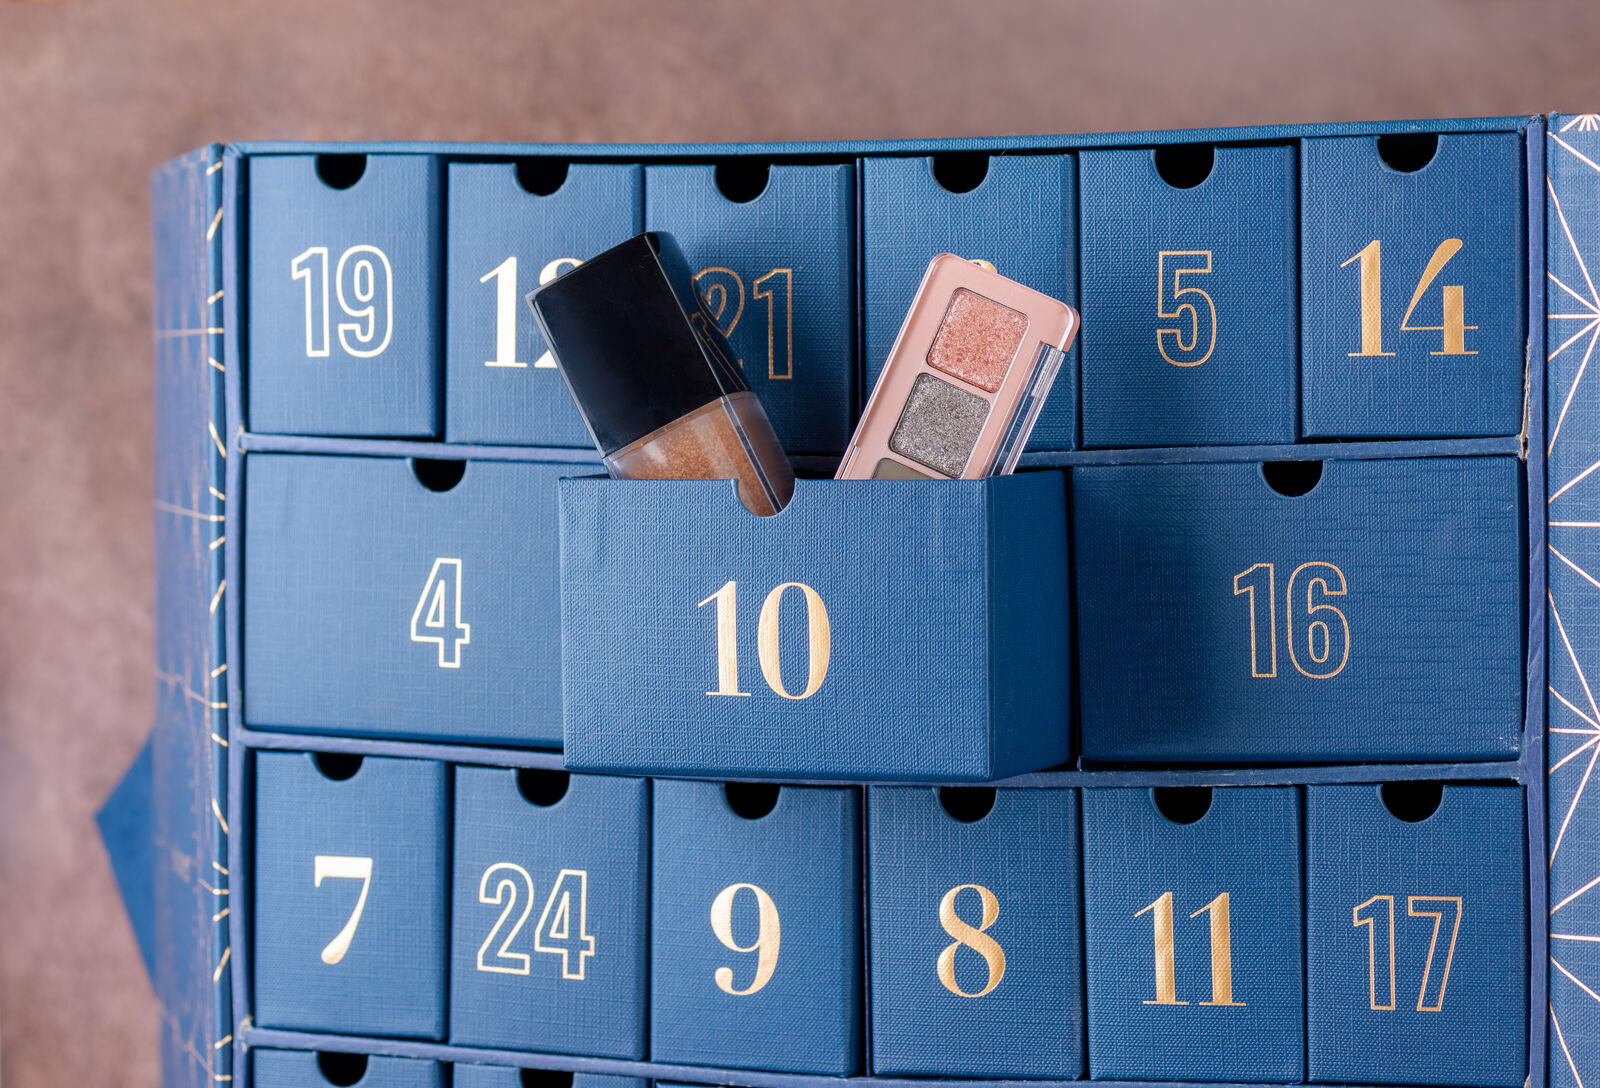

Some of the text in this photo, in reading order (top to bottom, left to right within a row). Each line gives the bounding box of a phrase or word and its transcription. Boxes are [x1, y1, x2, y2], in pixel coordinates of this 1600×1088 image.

[292, 246, 393, 358] 19
[1157, 250, 1216, 367] 5
[1340, 238, 1478, 357] 14
[411, 558, 470, 668] 4
[698, 581, 830, 699] 10
[1234, 562, 1349, 679] 16
[314, 856, 373, 964] 7
[477, 863, 595, 980] 24
[711, 883, 780, 995] 9
[937, 884, 1005, 997] 8
[1135, 892, 1246, 1006] 11
[1353, 895, 1462, 1011] 17
